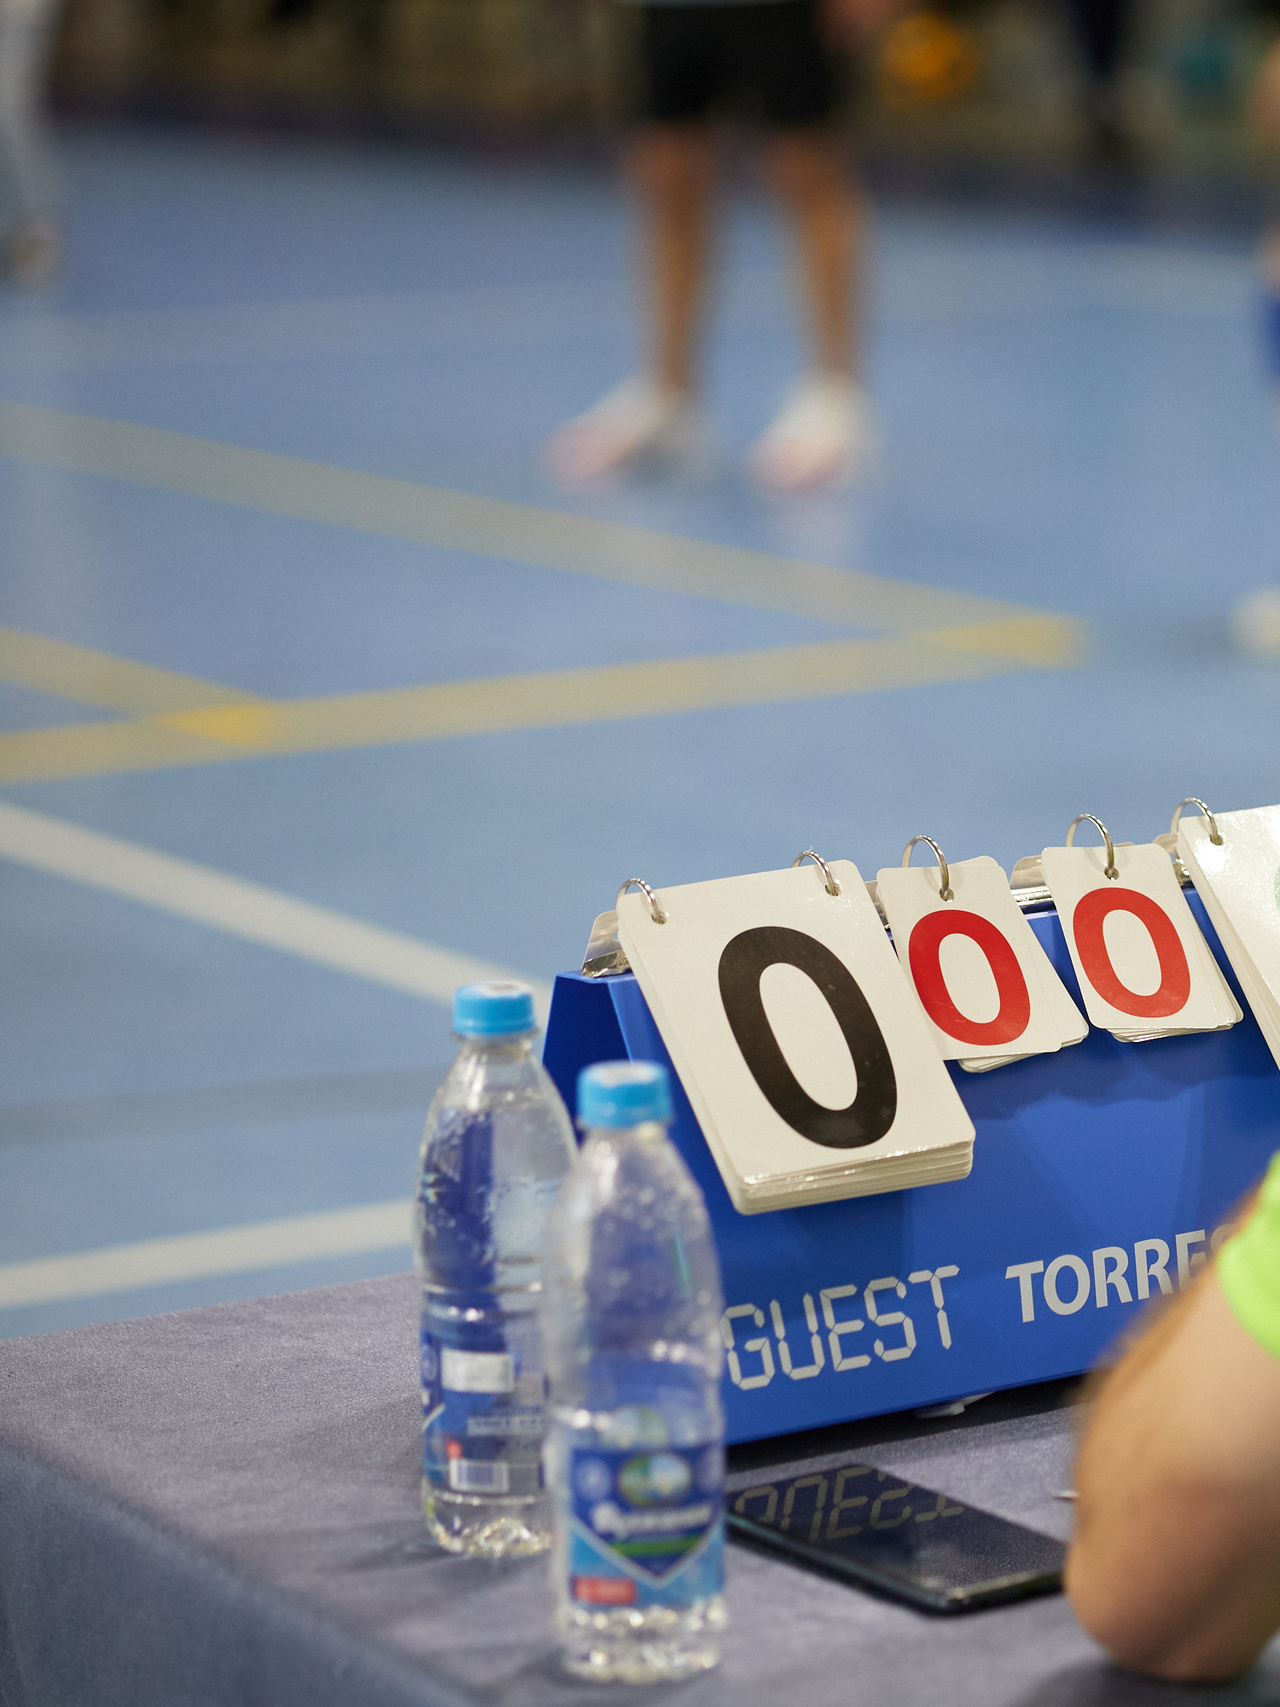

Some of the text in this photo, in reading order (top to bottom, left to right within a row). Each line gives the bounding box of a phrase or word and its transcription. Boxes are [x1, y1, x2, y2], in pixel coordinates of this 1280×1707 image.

[908, 909, 1031, 1046] 0
[1073, 887, 1191, 1018] 0
[717, 926, 898, 1149] 0
[722, 1264, 960, 1390] GUEST
